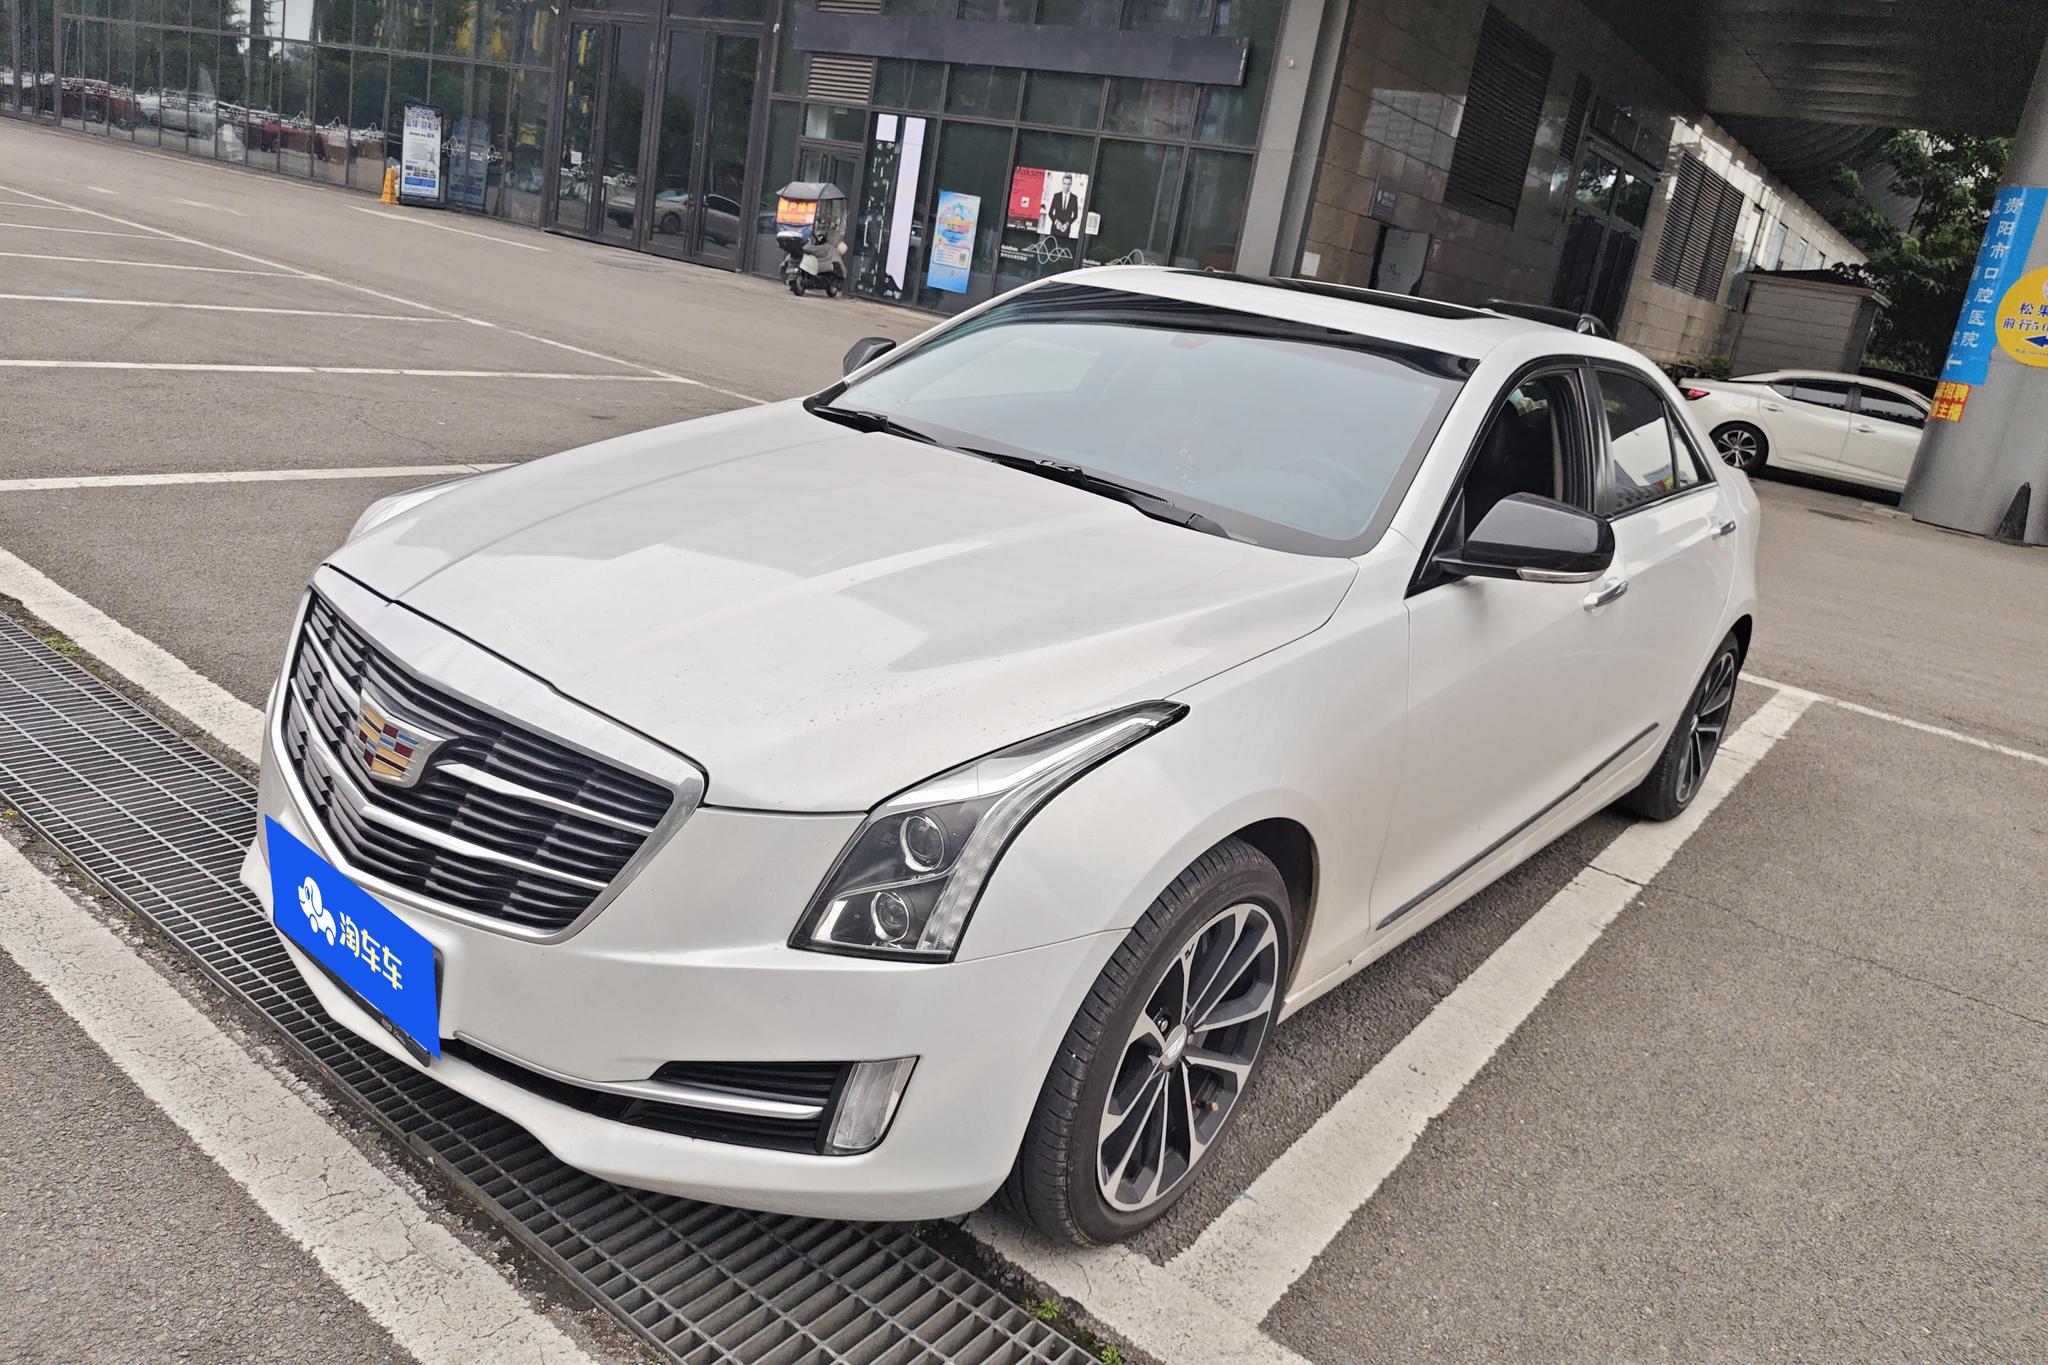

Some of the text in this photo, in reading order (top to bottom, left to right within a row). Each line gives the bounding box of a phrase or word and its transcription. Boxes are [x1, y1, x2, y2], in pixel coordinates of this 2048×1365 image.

[1960, 197, 2025, 349] 贵阳市口腔医院
